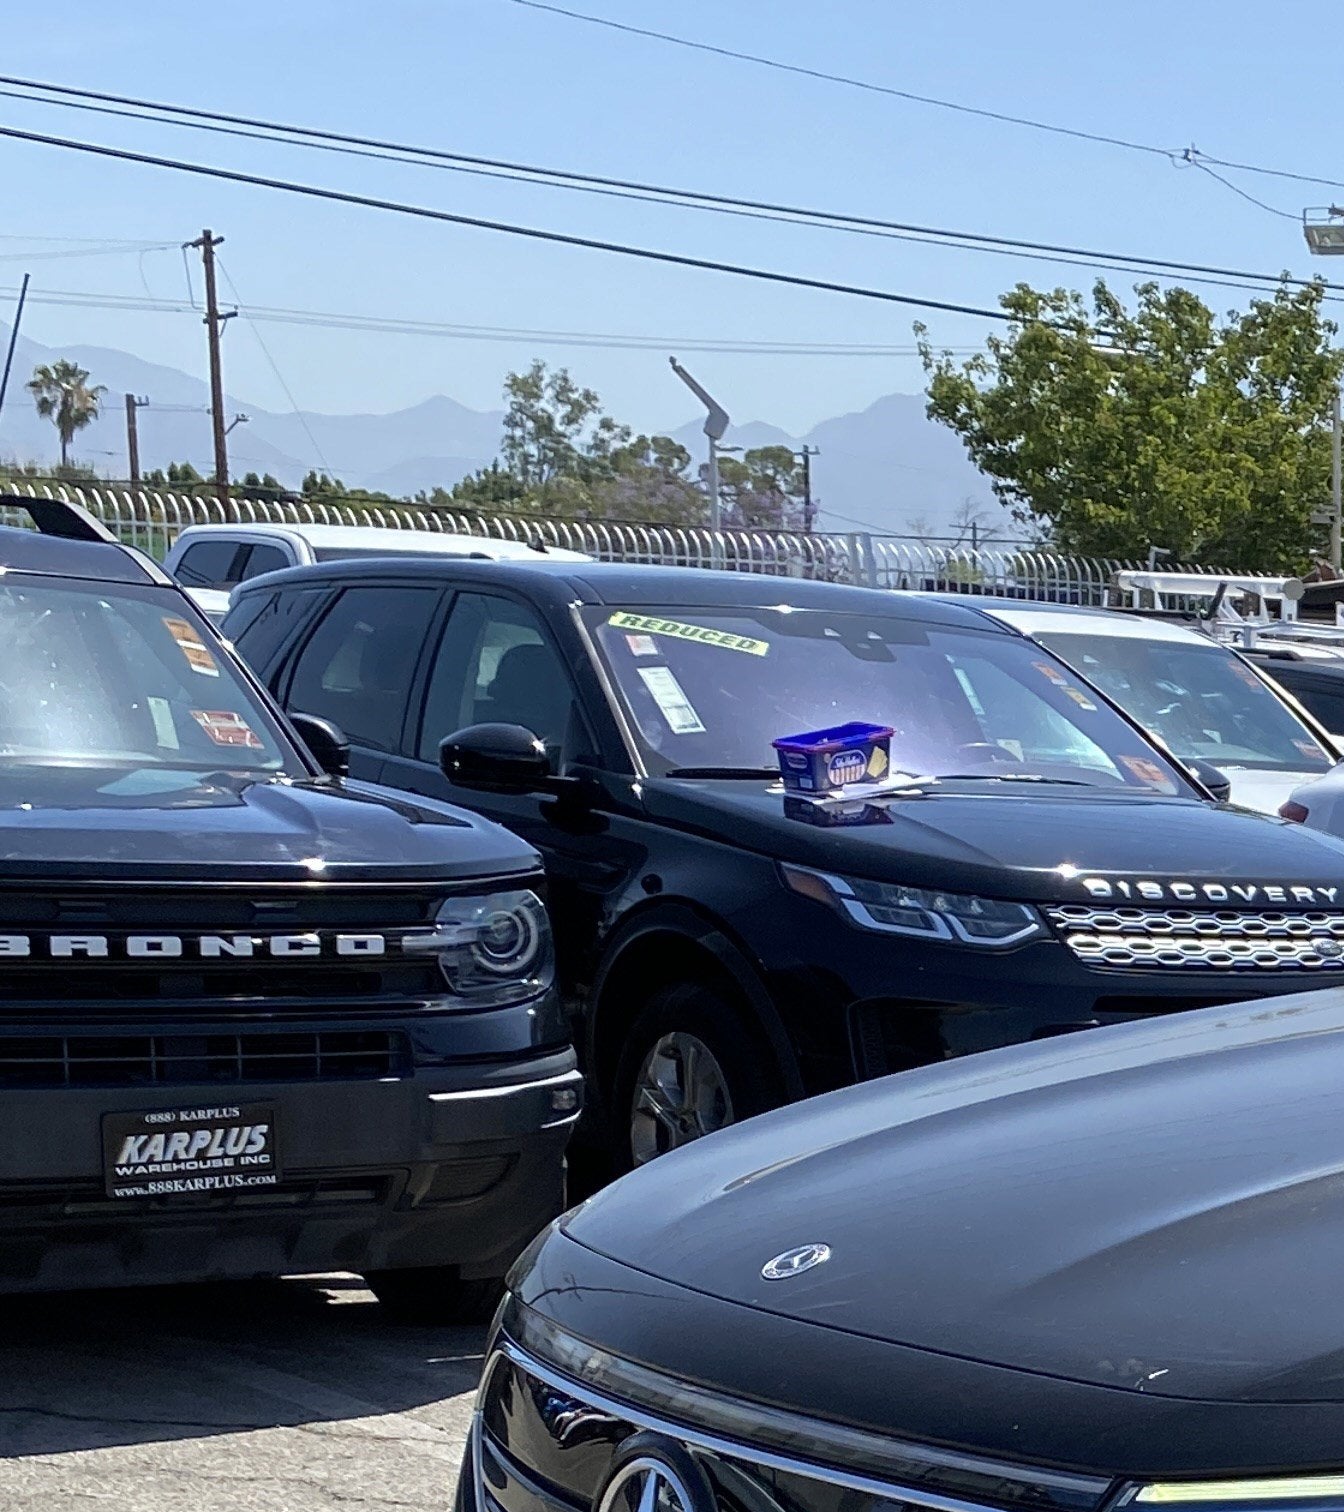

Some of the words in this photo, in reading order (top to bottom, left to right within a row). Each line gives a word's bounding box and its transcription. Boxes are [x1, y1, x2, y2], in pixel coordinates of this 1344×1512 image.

[619, 615, 758, 650] REDUCED
[1082, 878, 1339, 903] DISCOVERY
[0, 934, 385, 957] BRONCO
[144, 1112, 176, 1124] (888)
[179, 1107, 240, 1122] KARPLUS
[116, 1124, 269, 1165] KARPLUS
[114, 1157, 235, 1176] WAREHOUSE
[240, 1154, 271, 1165] INC
